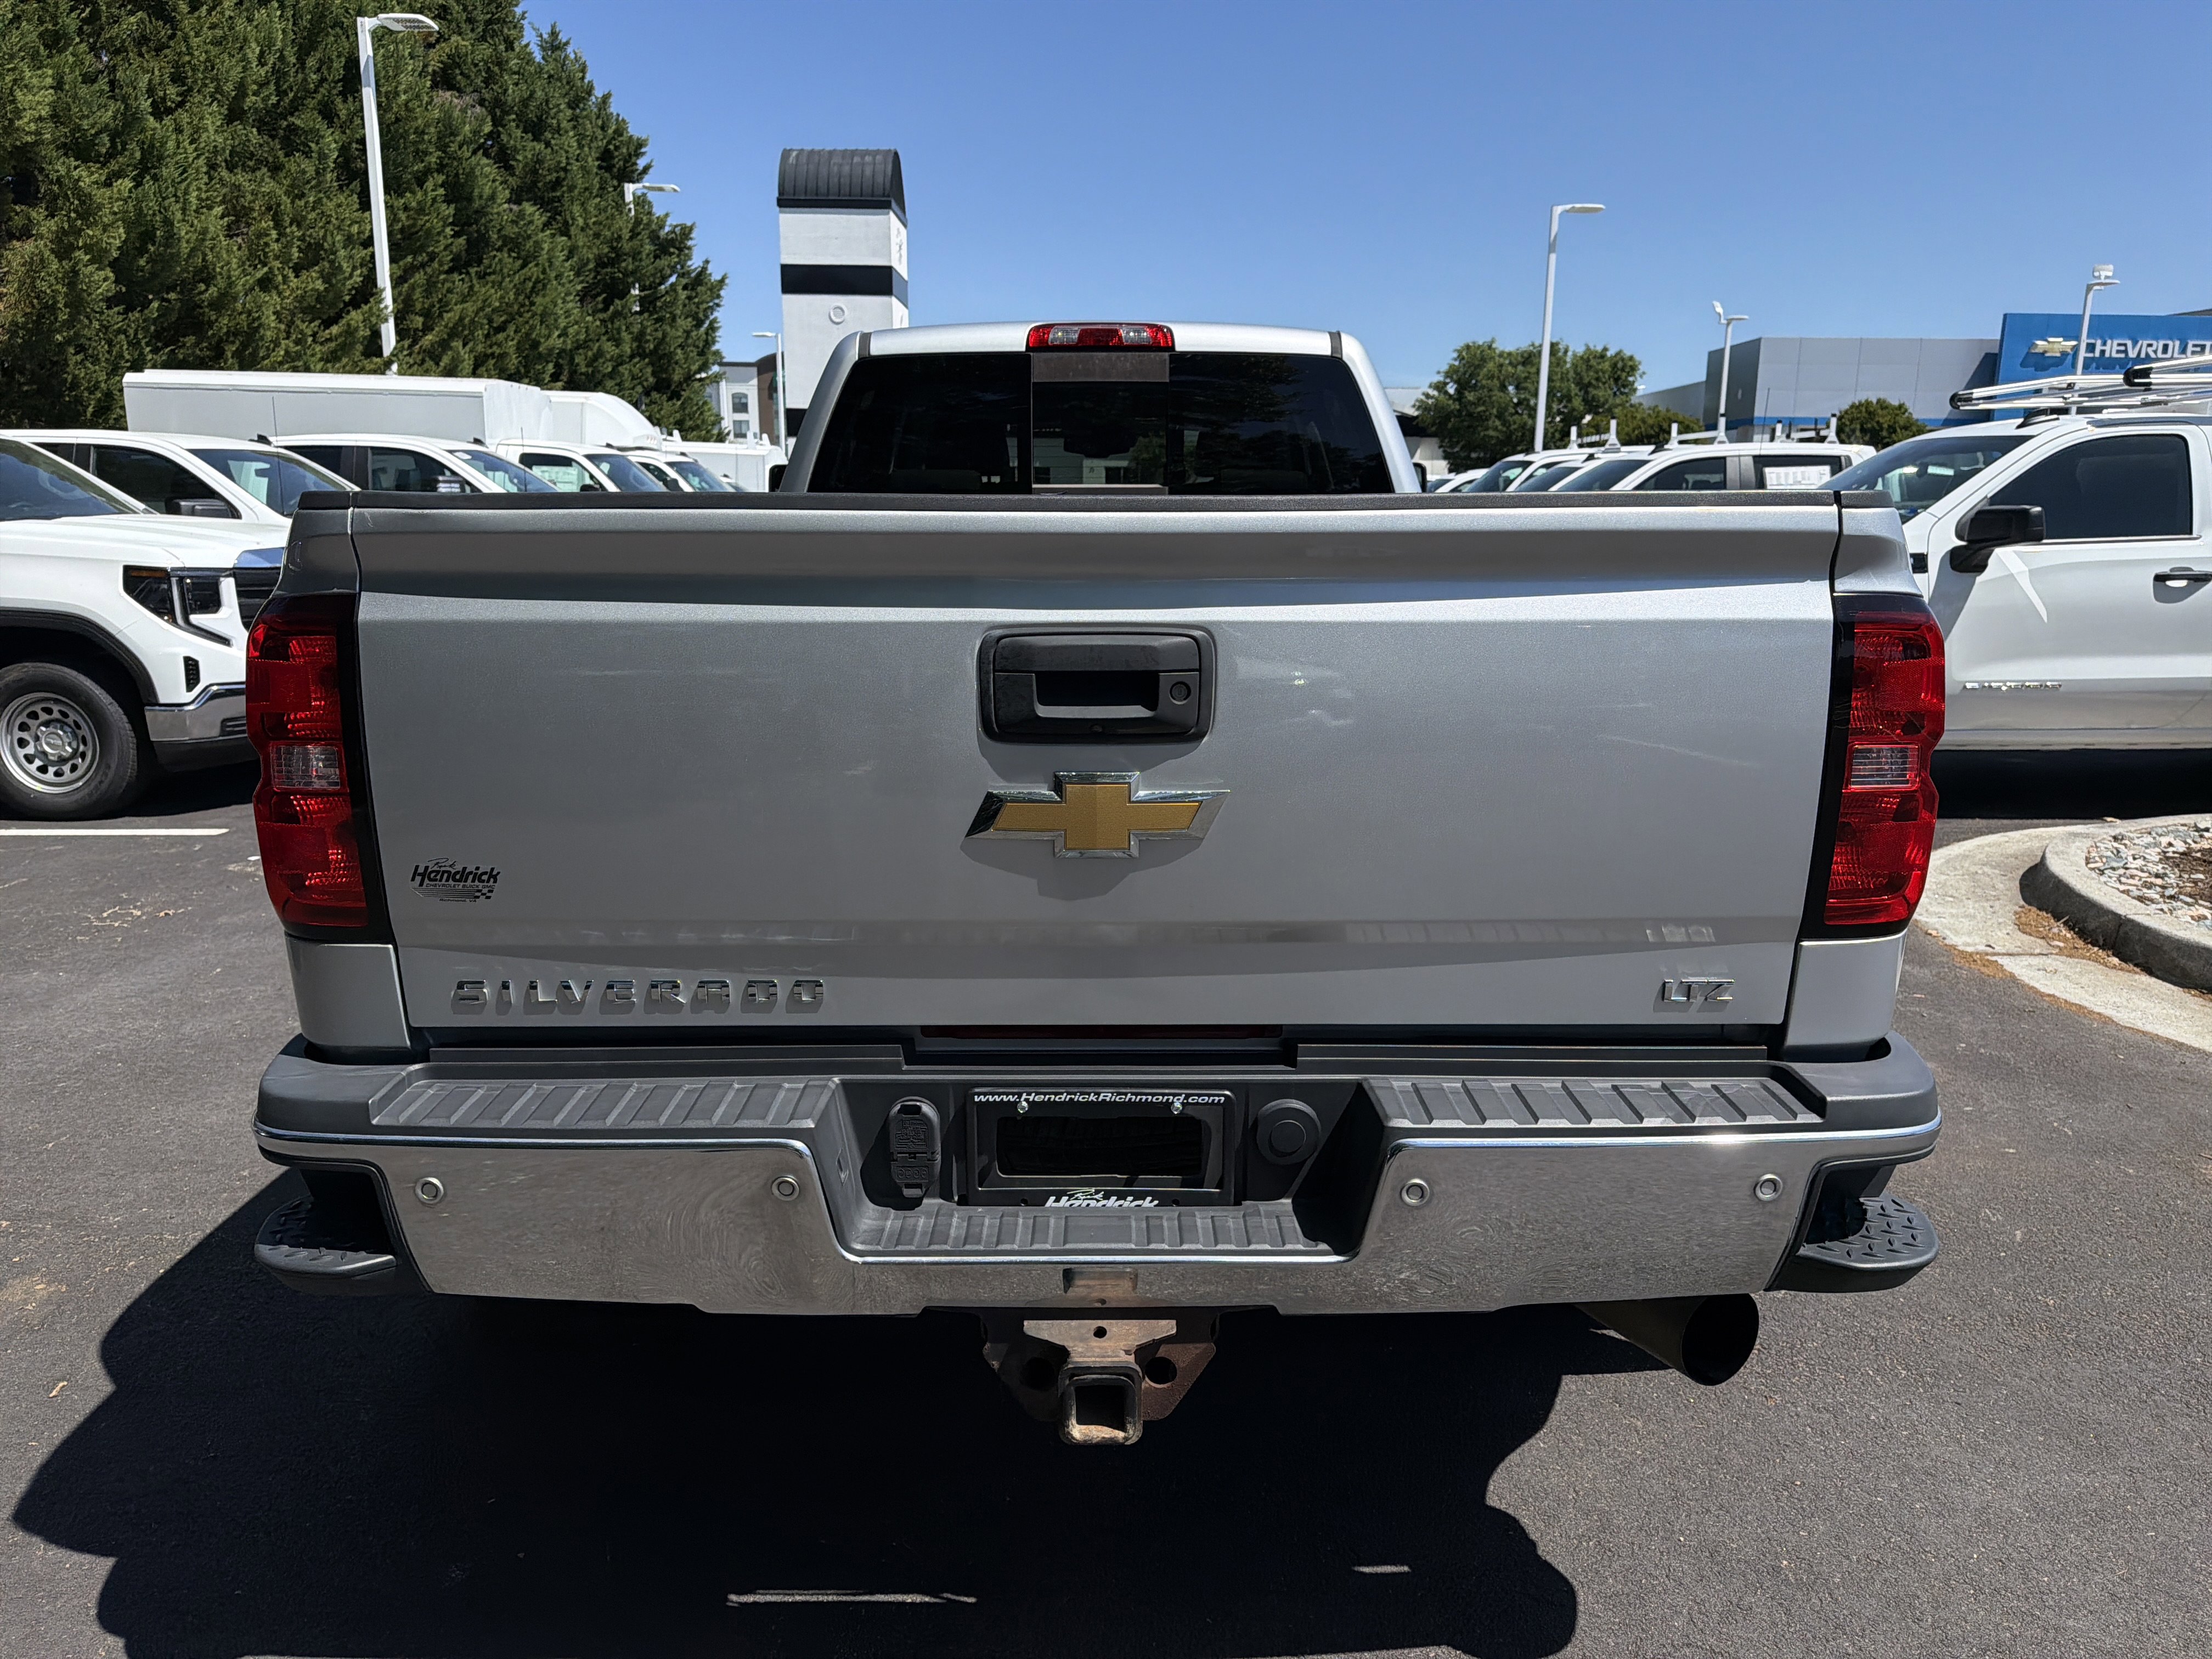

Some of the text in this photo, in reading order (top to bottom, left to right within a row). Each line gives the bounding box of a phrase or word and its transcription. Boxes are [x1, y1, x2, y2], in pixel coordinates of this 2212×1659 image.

[410, 865, 501, 887] Hendrick
[456, 979, 825, 1004] SILVERADO
[1662, 979, 1735, 1002] LTZ
[974, 1092, 1225, 1104] www.HendrickRichmond.com
